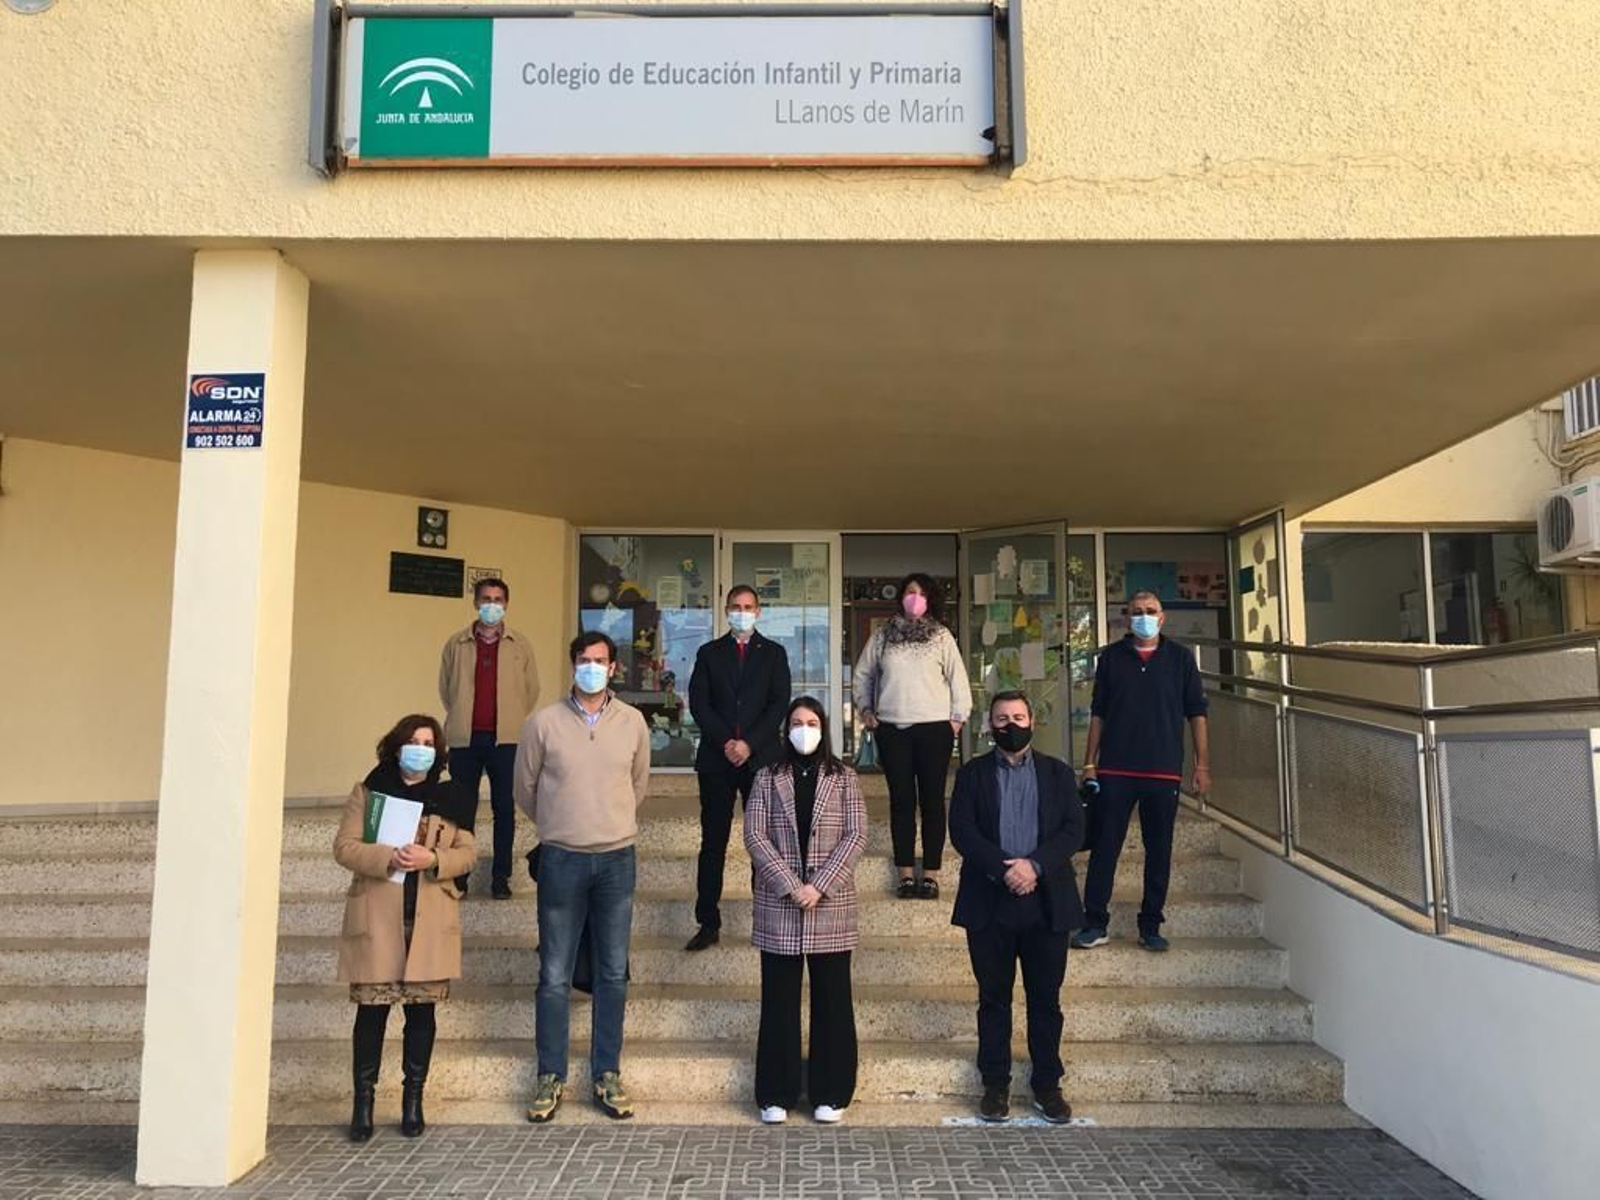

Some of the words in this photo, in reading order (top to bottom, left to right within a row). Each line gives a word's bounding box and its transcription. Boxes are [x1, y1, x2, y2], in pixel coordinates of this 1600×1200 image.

[522, 62, 600, 90] Colegio
[609, 62, 634, 85] de
[643, 61, 755, 85] Educación
[765, 61, 841, 85] Infantil
[850, 67, 862, 90] y
[870, 61, 961, 85] Primaria
[775, 99, 855, 124] LLanos
[863, 99, 890, 124] de
[900, 97, 964, 124] Marín
[375, 113, 405, 124] JUNTA
[409, 113, 421, 124] DE
[210, 386, 260, 399] SDN
[189, 410, 242, 422] ALARMA
[194, 435, 213, 447] 902
[215, 434, 234, 446] 502
[236, 434, 254, 446] 600
